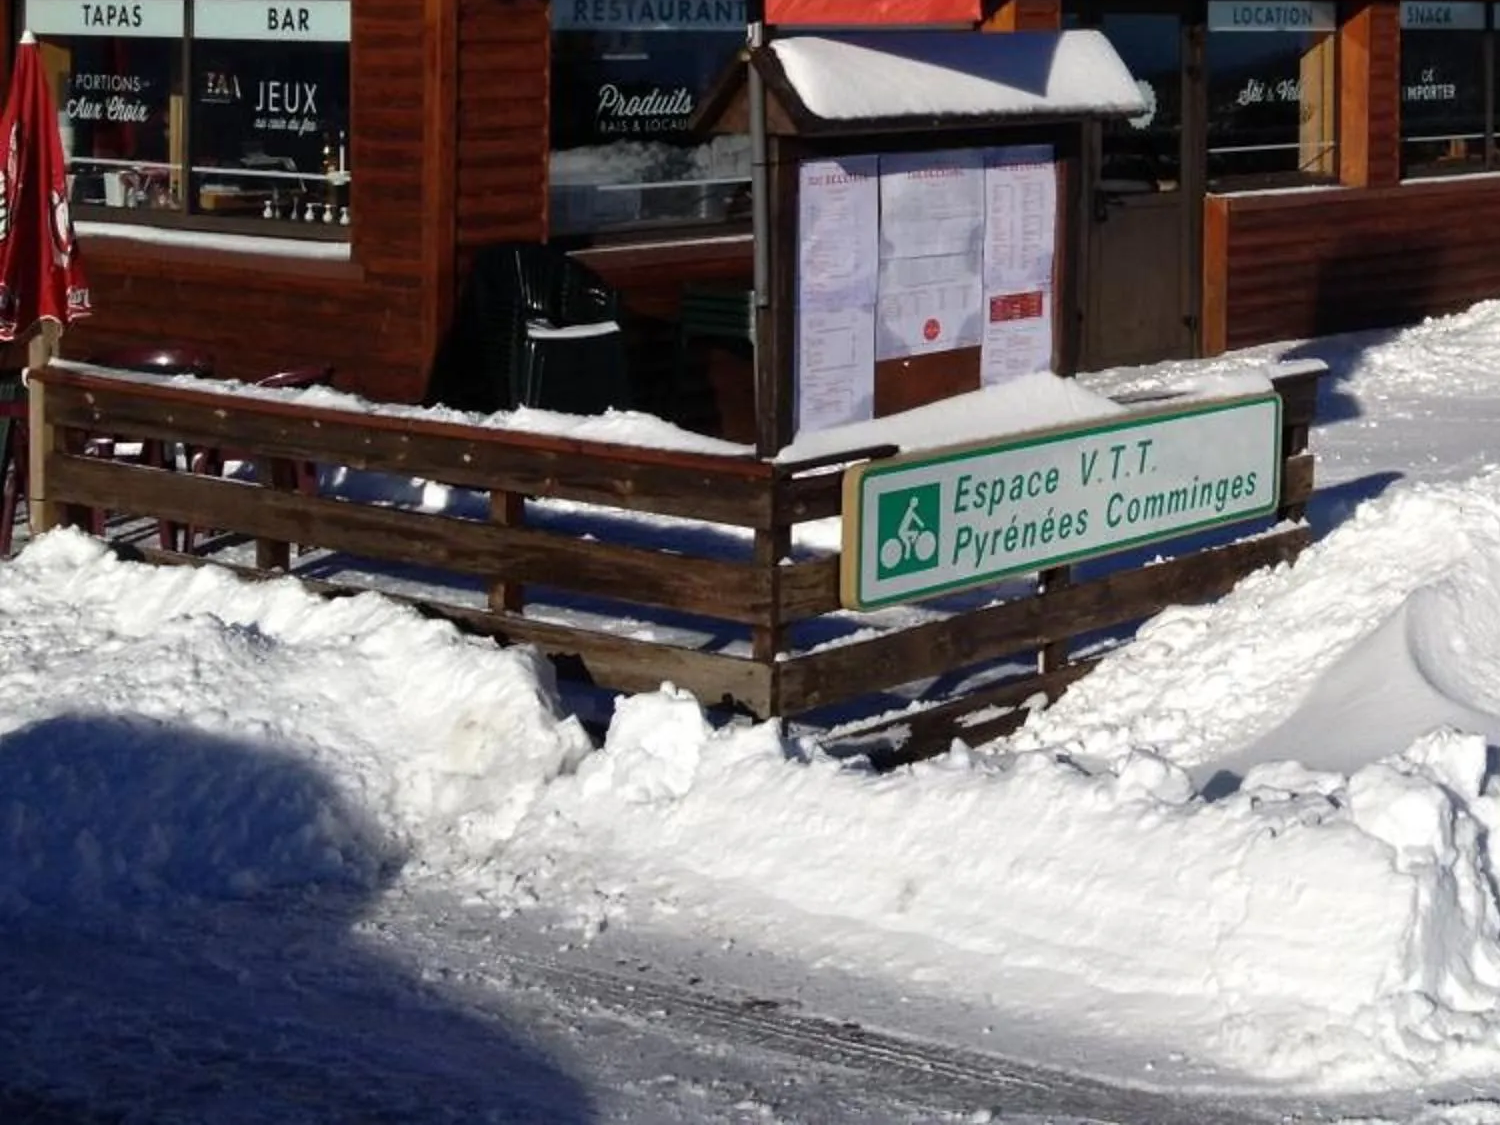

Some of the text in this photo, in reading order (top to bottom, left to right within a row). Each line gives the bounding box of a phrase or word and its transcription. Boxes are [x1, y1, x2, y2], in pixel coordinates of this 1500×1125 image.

[82, 4, 143, 27] TAPAS
[267, 8, 310, 31] BAR
[573, 0, 746, 22] RESTAURANT
[1232, 6, 1313, 25] LOCATION
[1407, 6, 1452, 25] SNACK
[75, 75, 141, 93] PORTIONS
[255, 80, 318, 114] JEUX
[599, 83, 695, 116] Produits
[645, 117, 697, 132] LOCAU
[953, 439, 1158, 516] Espace V.T.T.
[951, 469, 1257, 569] Pyrénées Comminges
